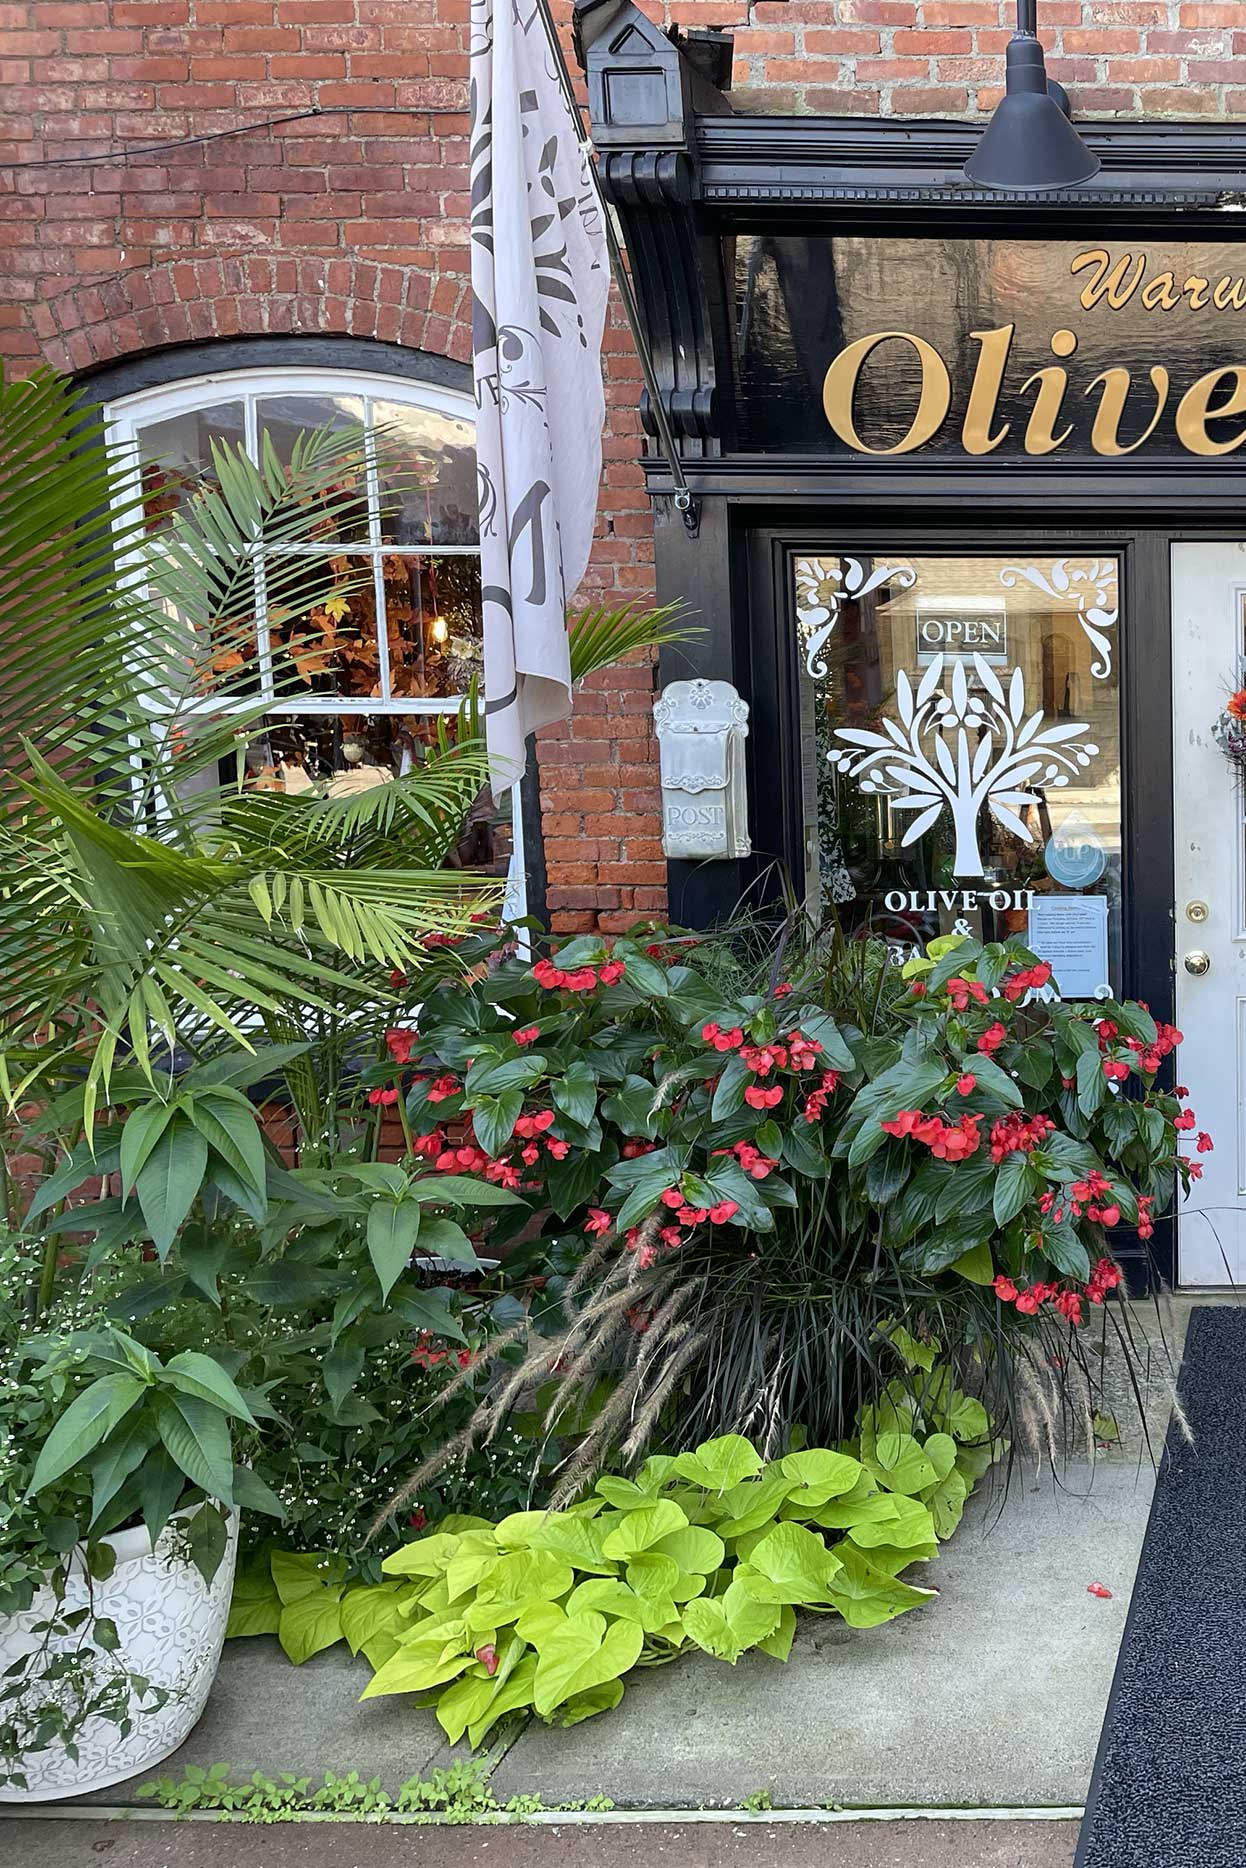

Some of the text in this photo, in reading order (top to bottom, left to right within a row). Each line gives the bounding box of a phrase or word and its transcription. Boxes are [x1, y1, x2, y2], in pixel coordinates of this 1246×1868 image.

[922, 620, 1000, 644] OPEN
[667, 807, 723, 826] POST
[884, 889, 1041, 912] OLIVE OIL
[951, 918, 974, 939] &
